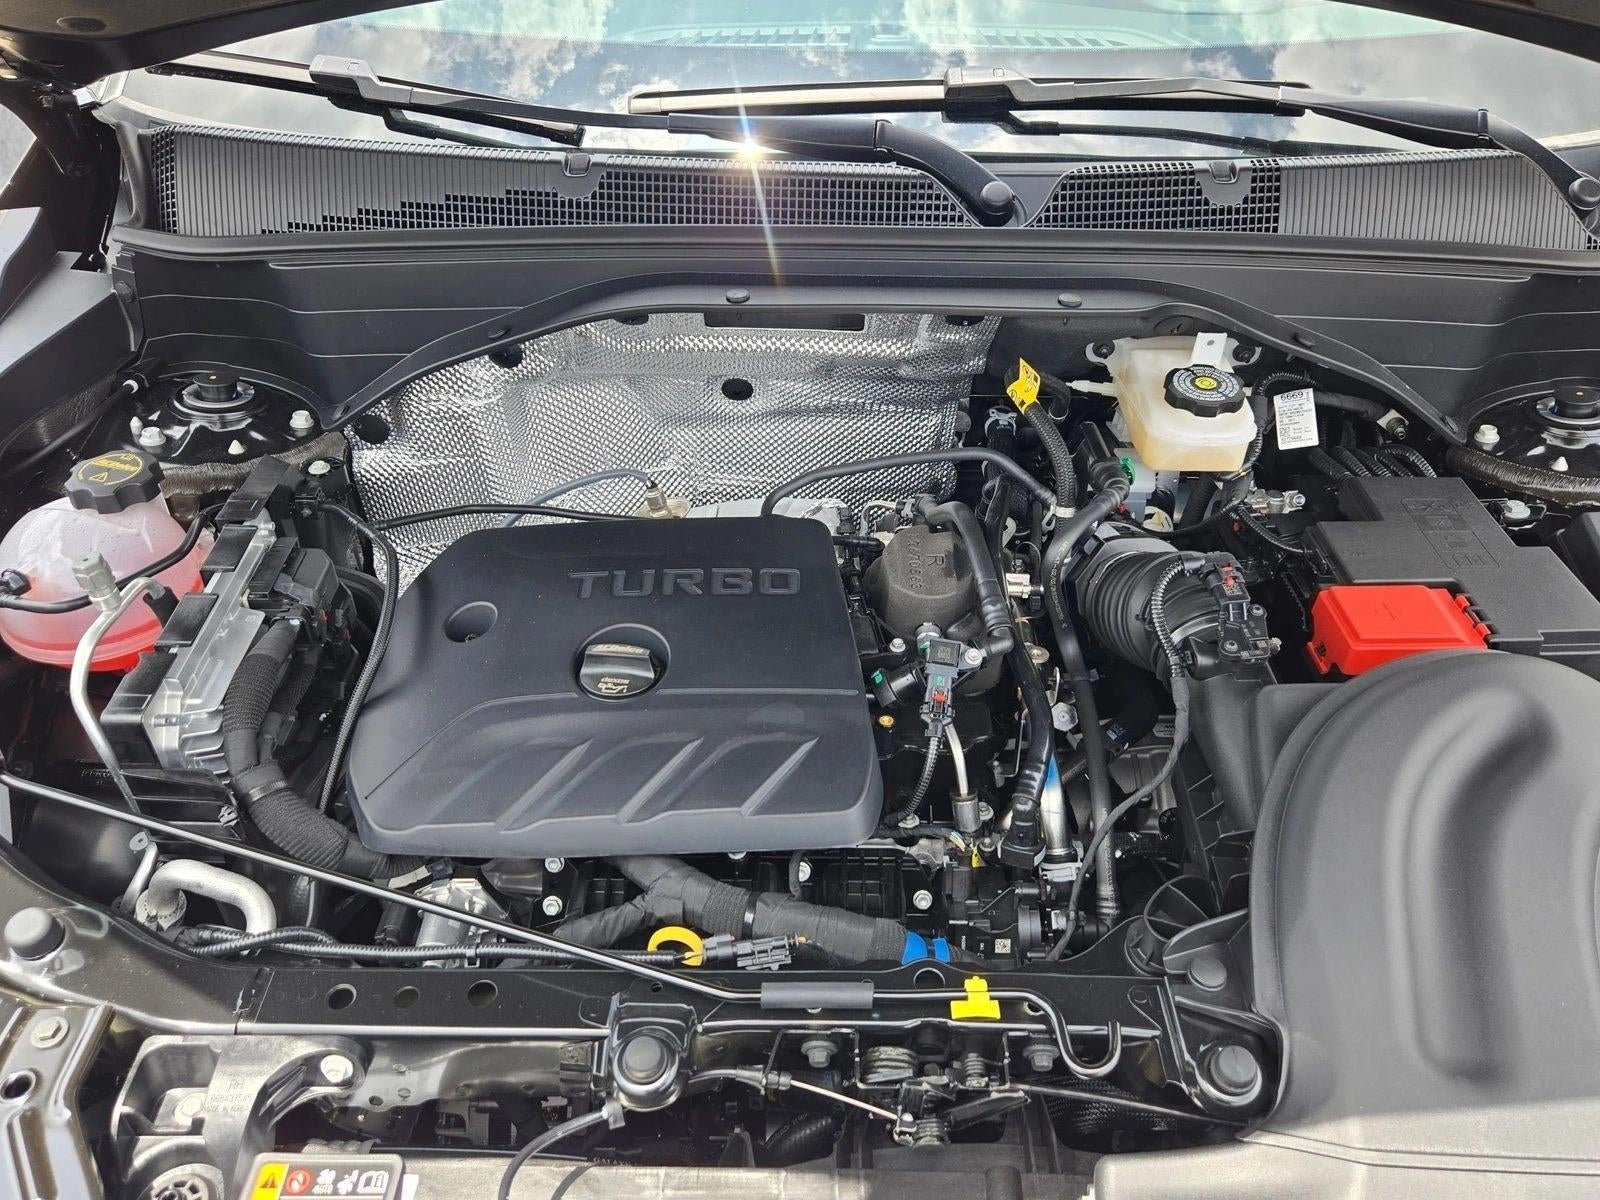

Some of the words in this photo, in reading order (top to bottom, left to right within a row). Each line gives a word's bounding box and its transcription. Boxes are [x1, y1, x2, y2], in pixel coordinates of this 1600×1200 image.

[927, 553, 946, 567] R
[568, 567, 801, 599] TURBO
[591, 643, 646, 656] ACDelco
